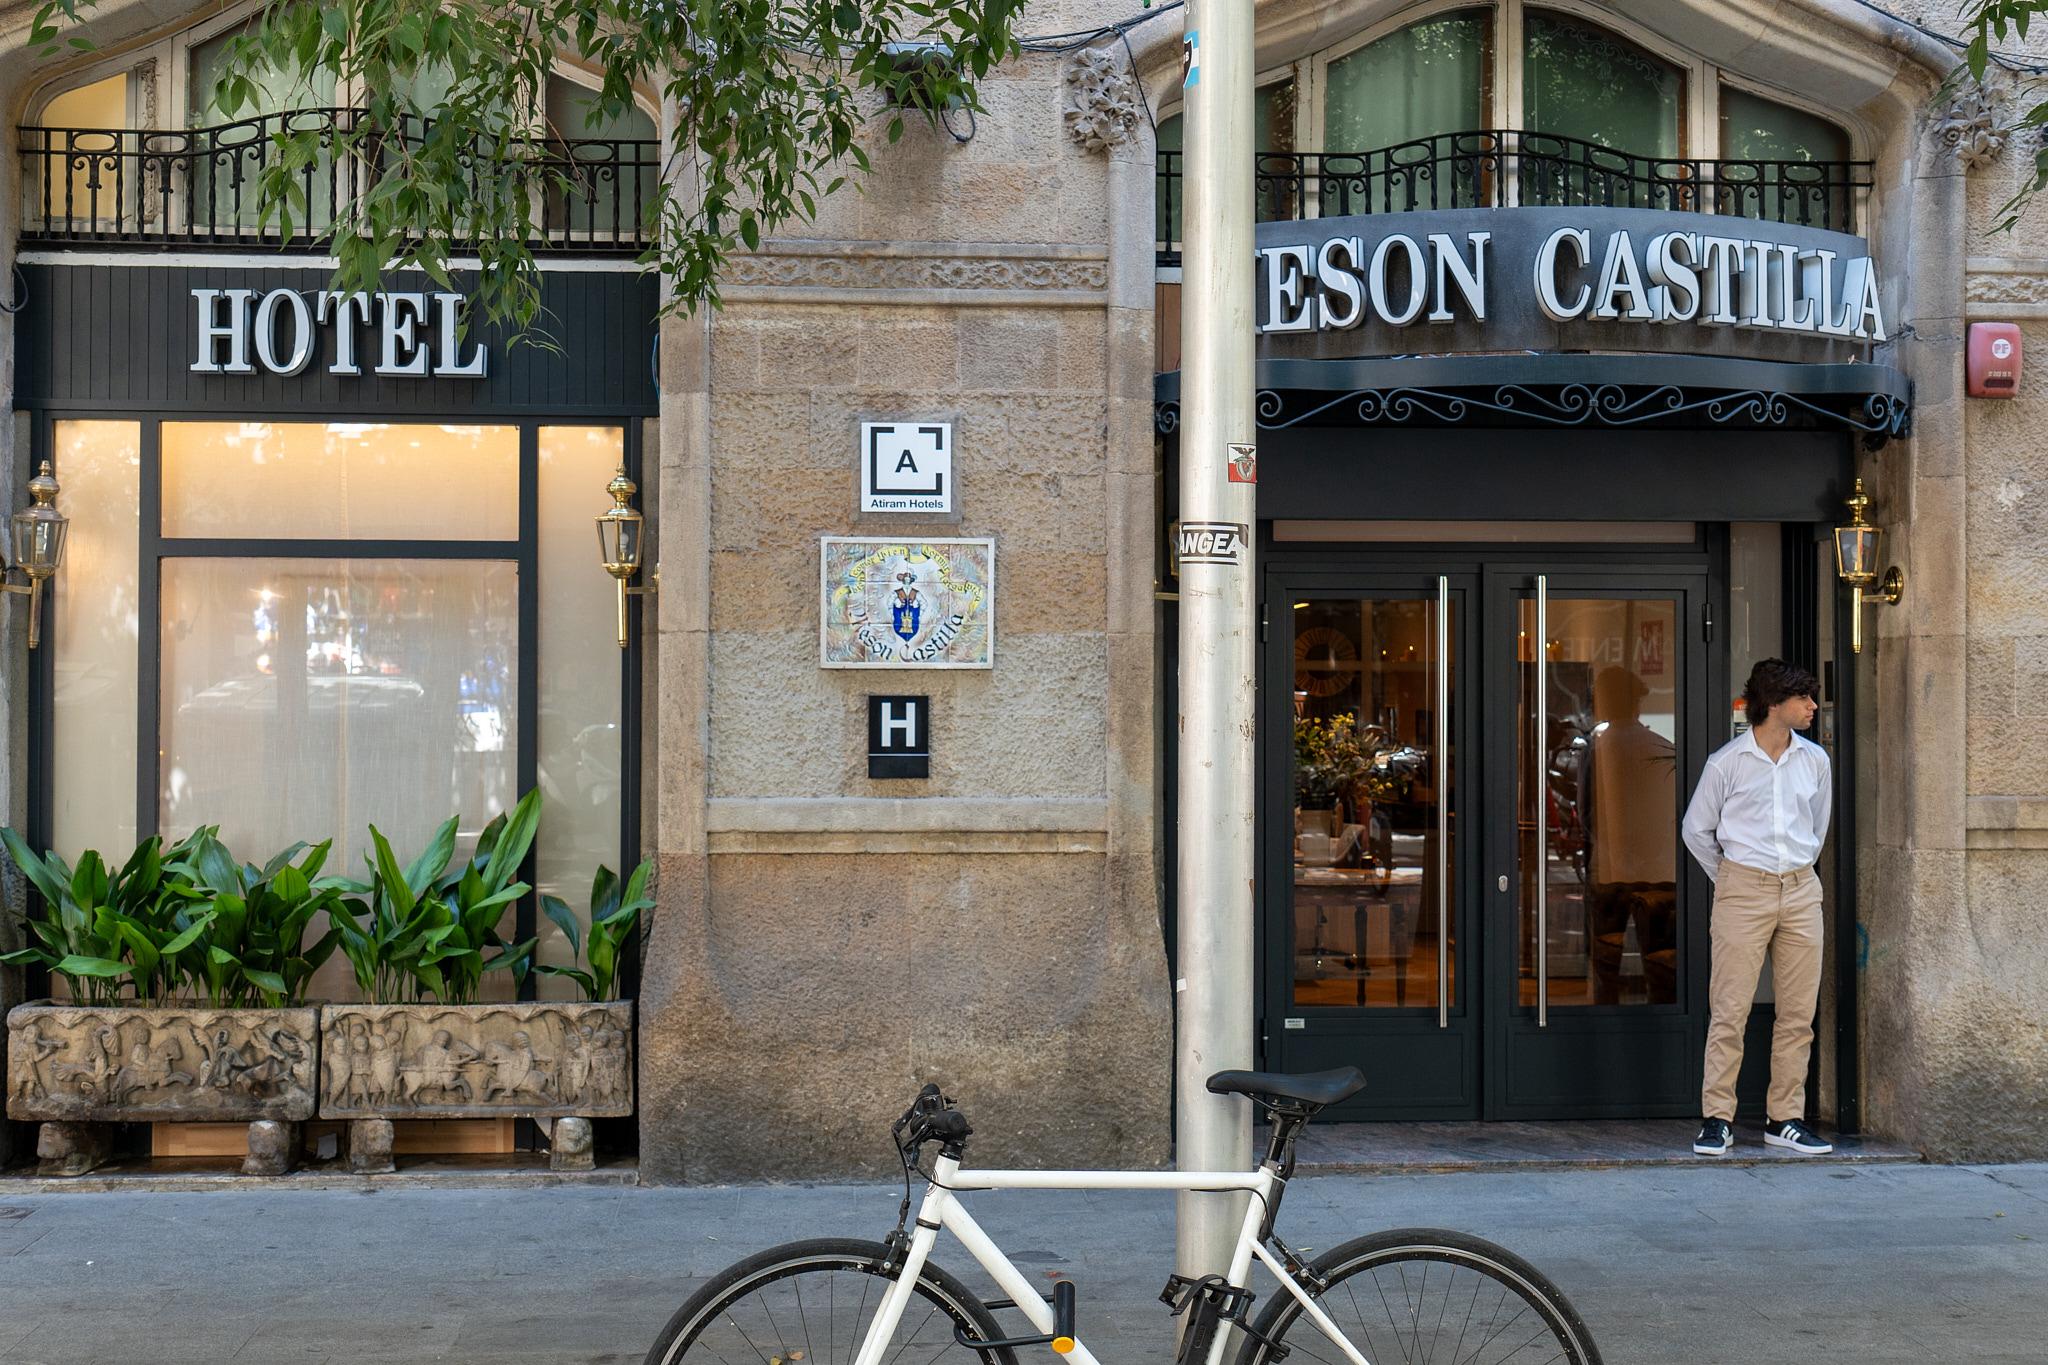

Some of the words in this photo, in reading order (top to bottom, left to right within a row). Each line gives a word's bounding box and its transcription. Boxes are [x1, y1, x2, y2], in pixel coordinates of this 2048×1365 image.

[1255, 231, 1491, 334] ESON
[1534, 226, 1887, 342] CASTILLA
[190, 288, 489, 378] HOTEL
[895, 449, 918, 473] A
[871, 499, 906, 508] Atiram
[909, 499, 944, 508] Hotels
[881, 702, 916, 747] H
